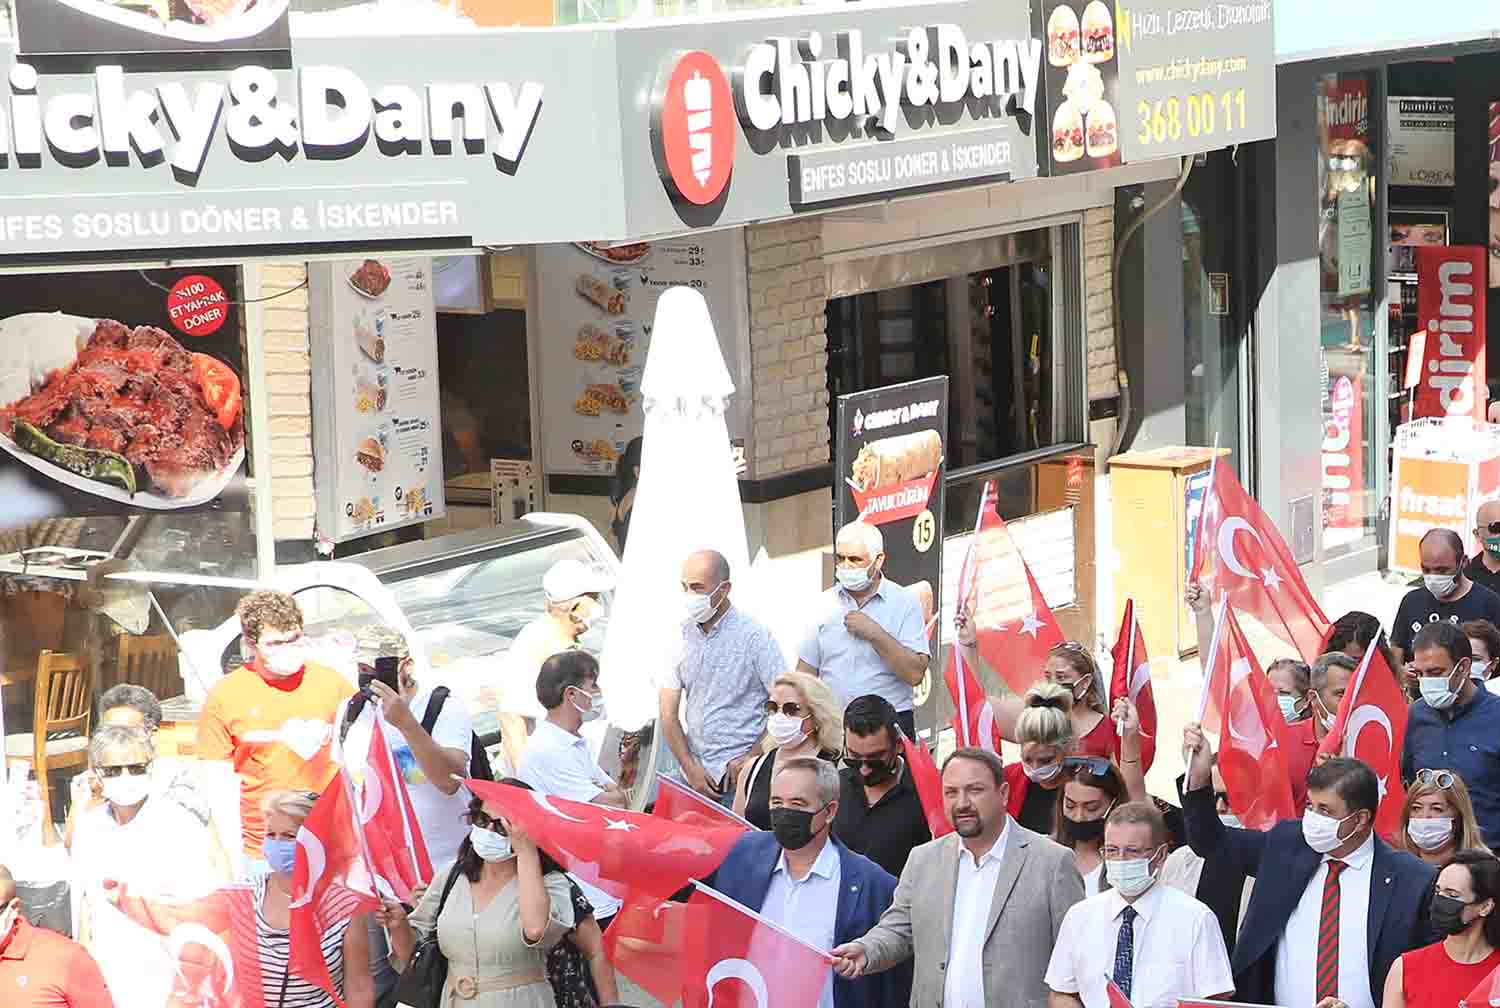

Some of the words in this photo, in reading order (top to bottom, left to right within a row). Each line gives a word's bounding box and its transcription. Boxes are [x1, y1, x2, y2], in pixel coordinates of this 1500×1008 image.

[744, 23, 1041, 134] Chicky&Dany
[0, 63, 544, 182] icky&Dany
[1136, 96, 1182, 144] 368
[1186, 90, 1216, 137] 00
[1221, 87, 1246, 132] 11
[803, 162, 845, 192] ENFES
[849, 157, 891, 185] SOSLU
[72, 210, 170, 238] SOSLU
[291, 207, 310, 231] &
[319, 199, 460, 231] İSKENDER
[170, 305, 184, 319] ET
[918, 519, 931, 543] 15
